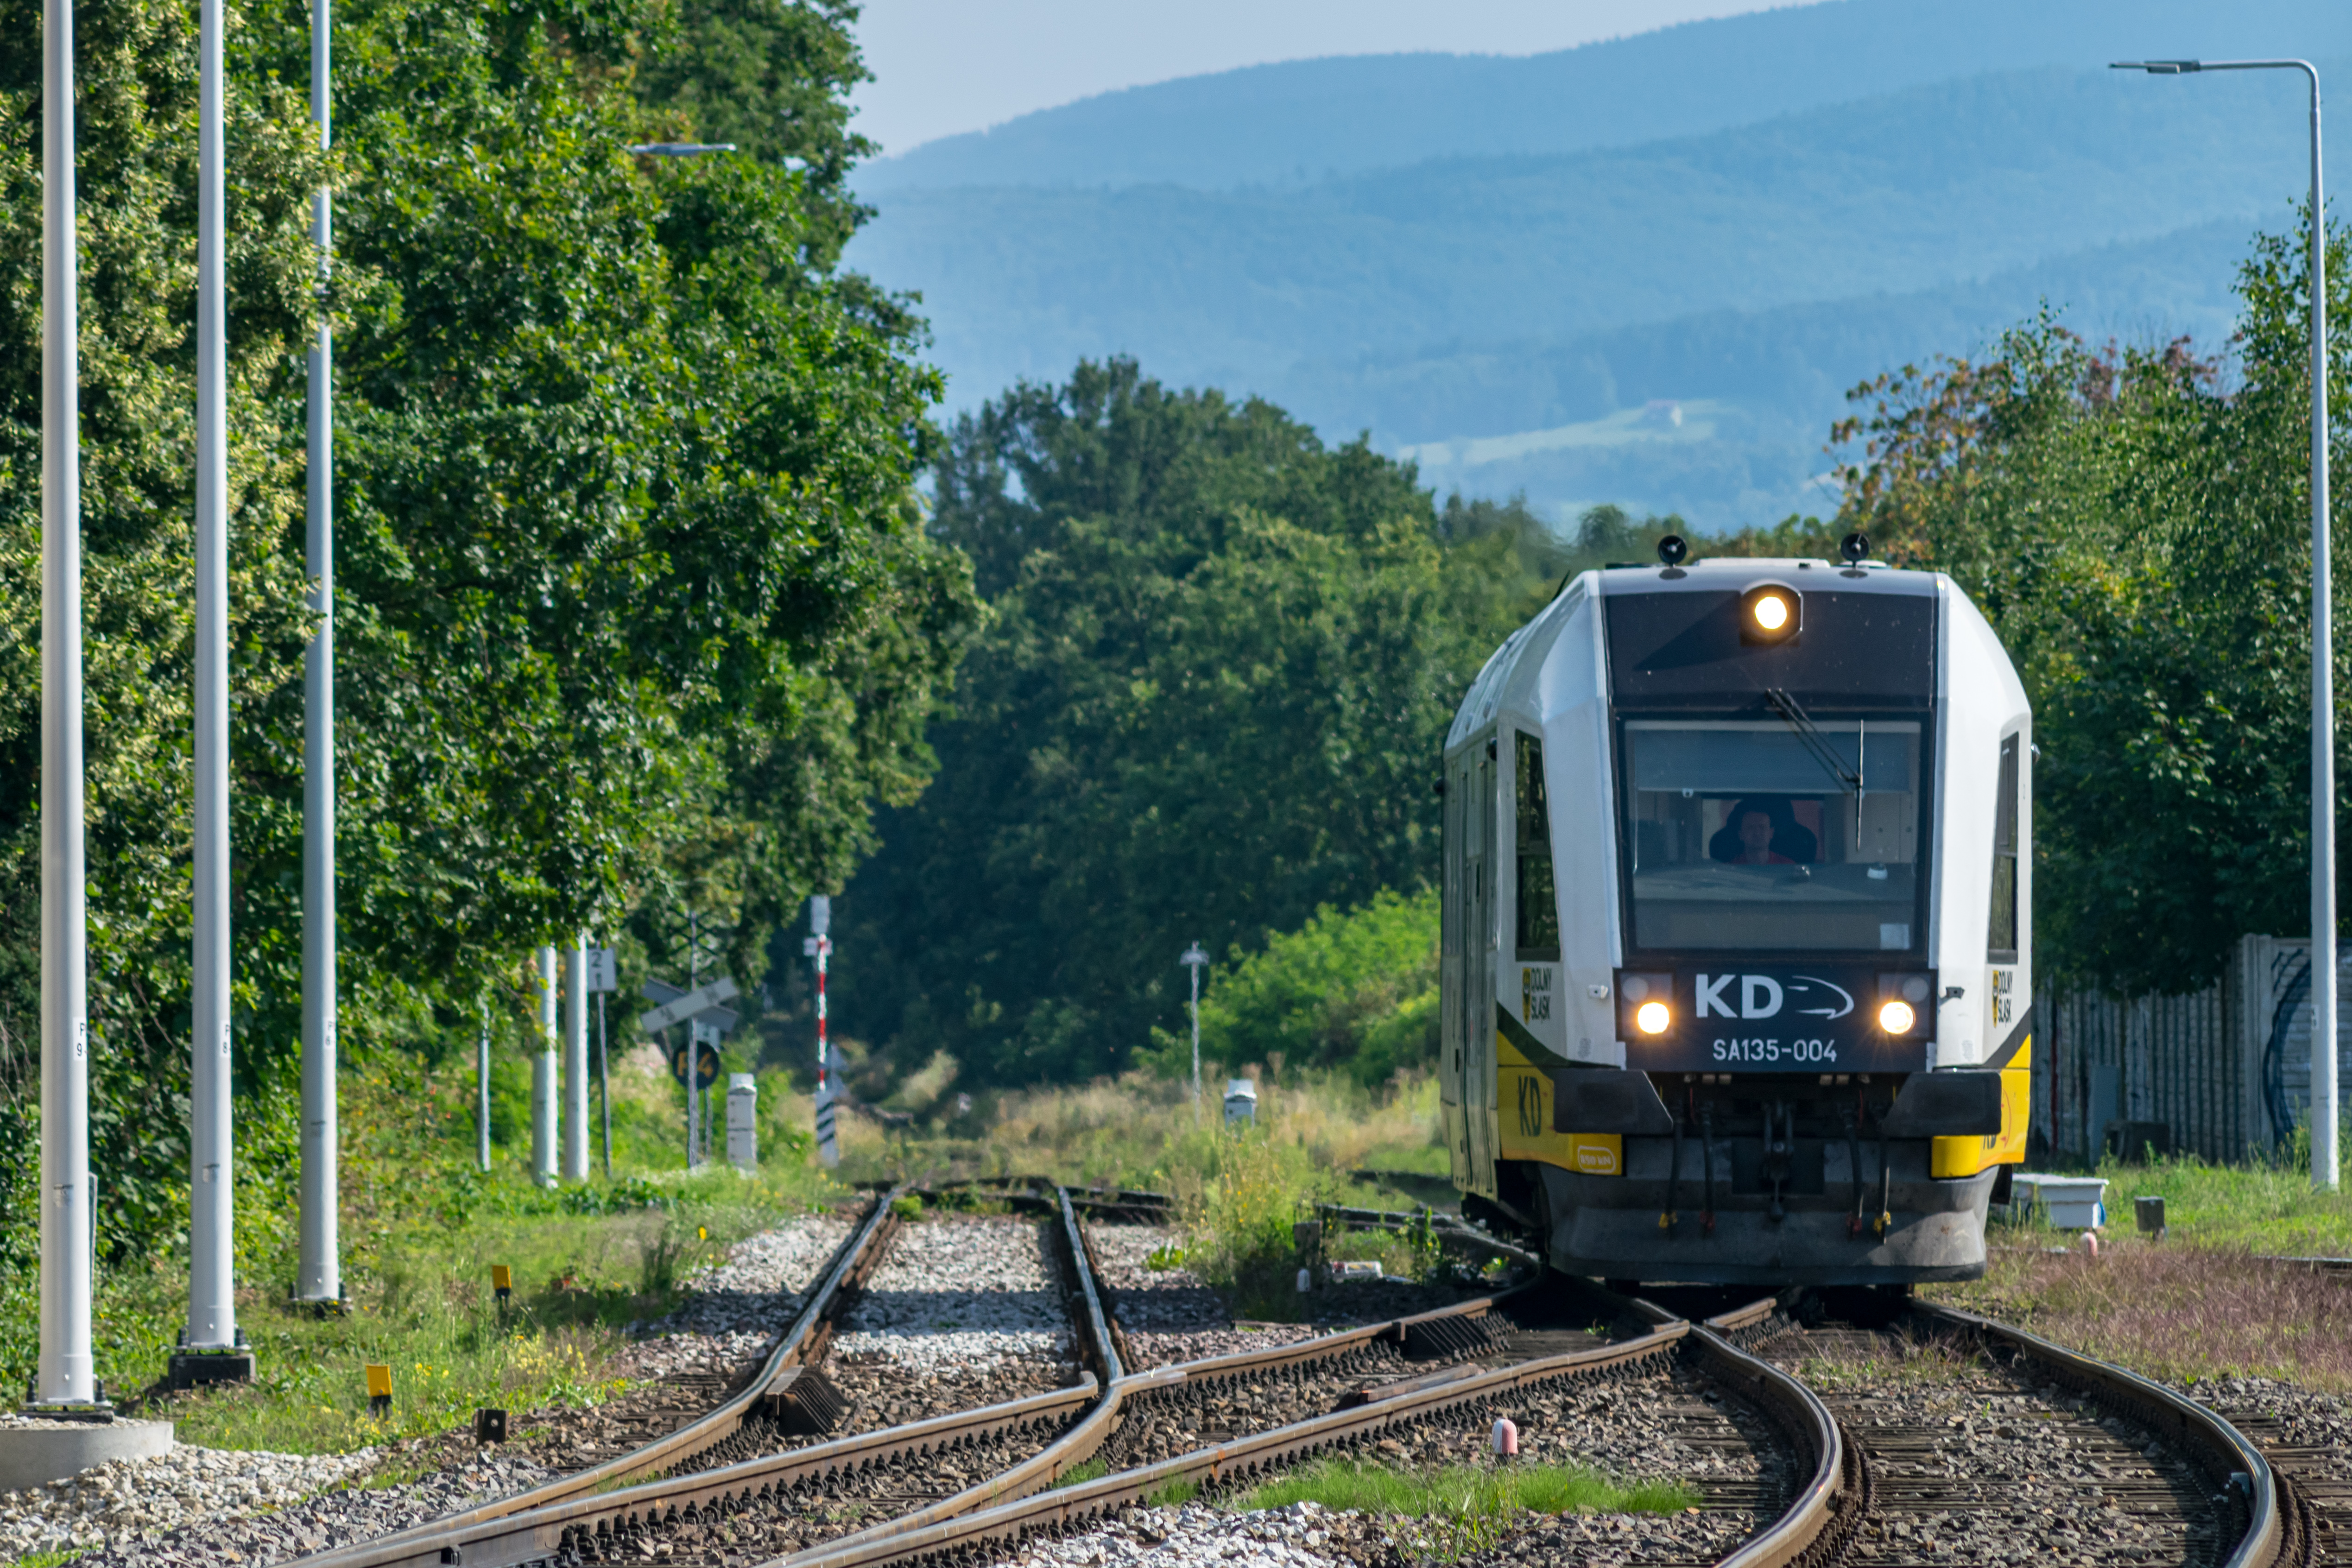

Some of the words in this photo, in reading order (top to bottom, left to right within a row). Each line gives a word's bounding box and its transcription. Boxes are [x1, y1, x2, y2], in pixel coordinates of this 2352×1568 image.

[591, 951, 601, 968] 2
[1531, 968, 1552, 991] DOLNY
[1999, 971, 2013, 993] DOLNY
[1695, 974, 1783, 1018] KD
[1713, 1038, 1837, 1062] SA135-004
[1518, 1075, 1542, 1137] KD
